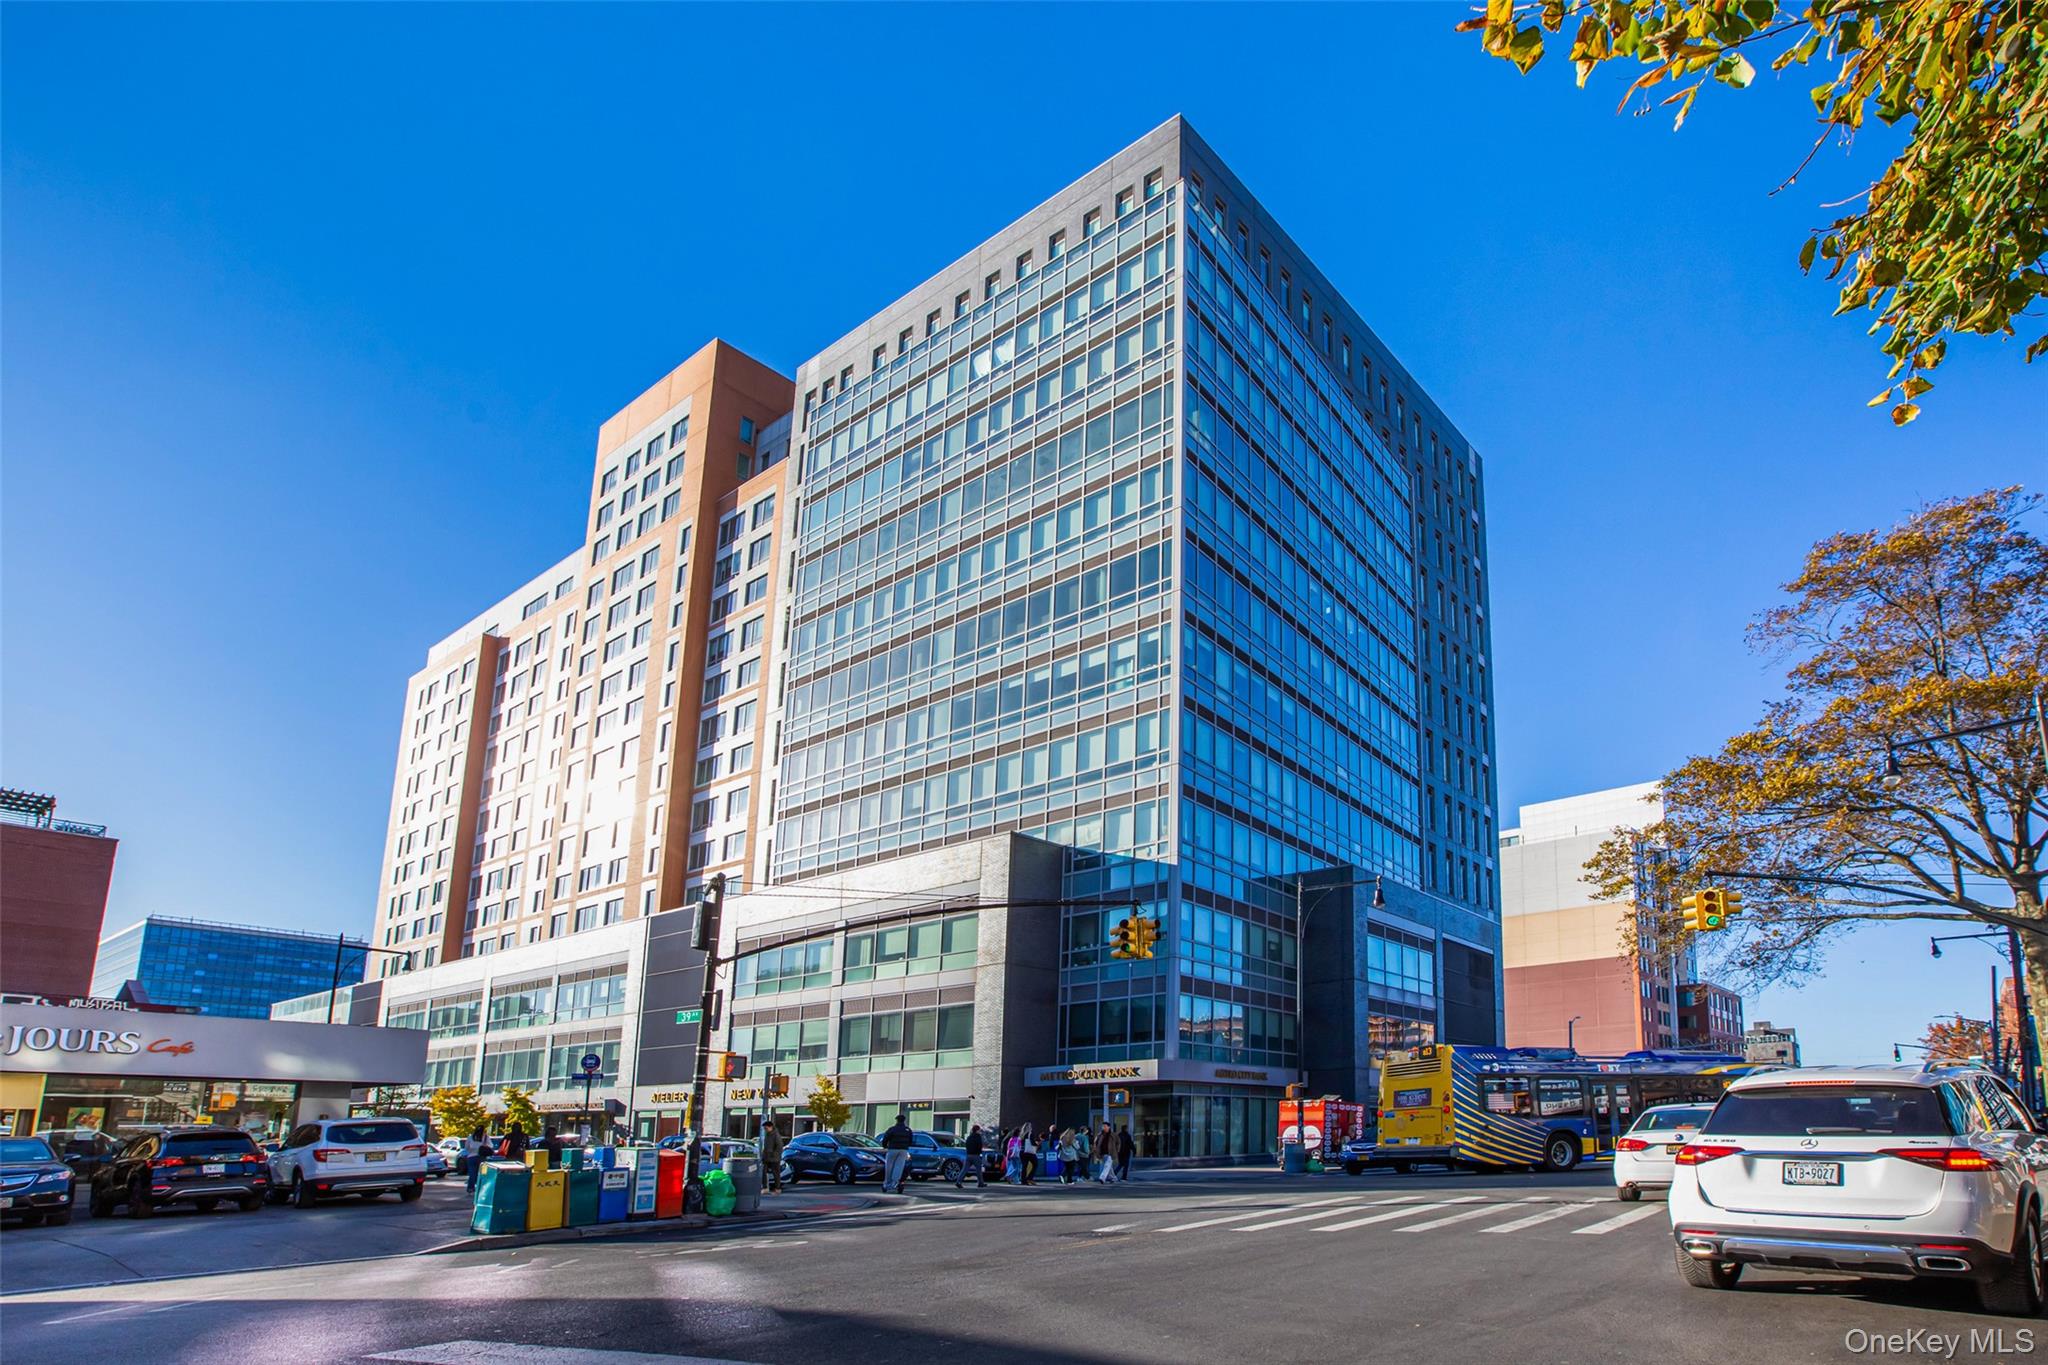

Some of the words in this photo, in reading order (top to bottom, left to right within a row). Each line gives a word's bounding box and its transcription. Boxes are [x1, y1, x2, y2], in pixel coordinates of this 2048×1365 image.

[681, 1012, 691, 1022] 39
[5, 1025, 141, 1055] JOURS
[651, 1091, 688, 1103] ATELIER
[731, 1088, 756, 1101] NEW
